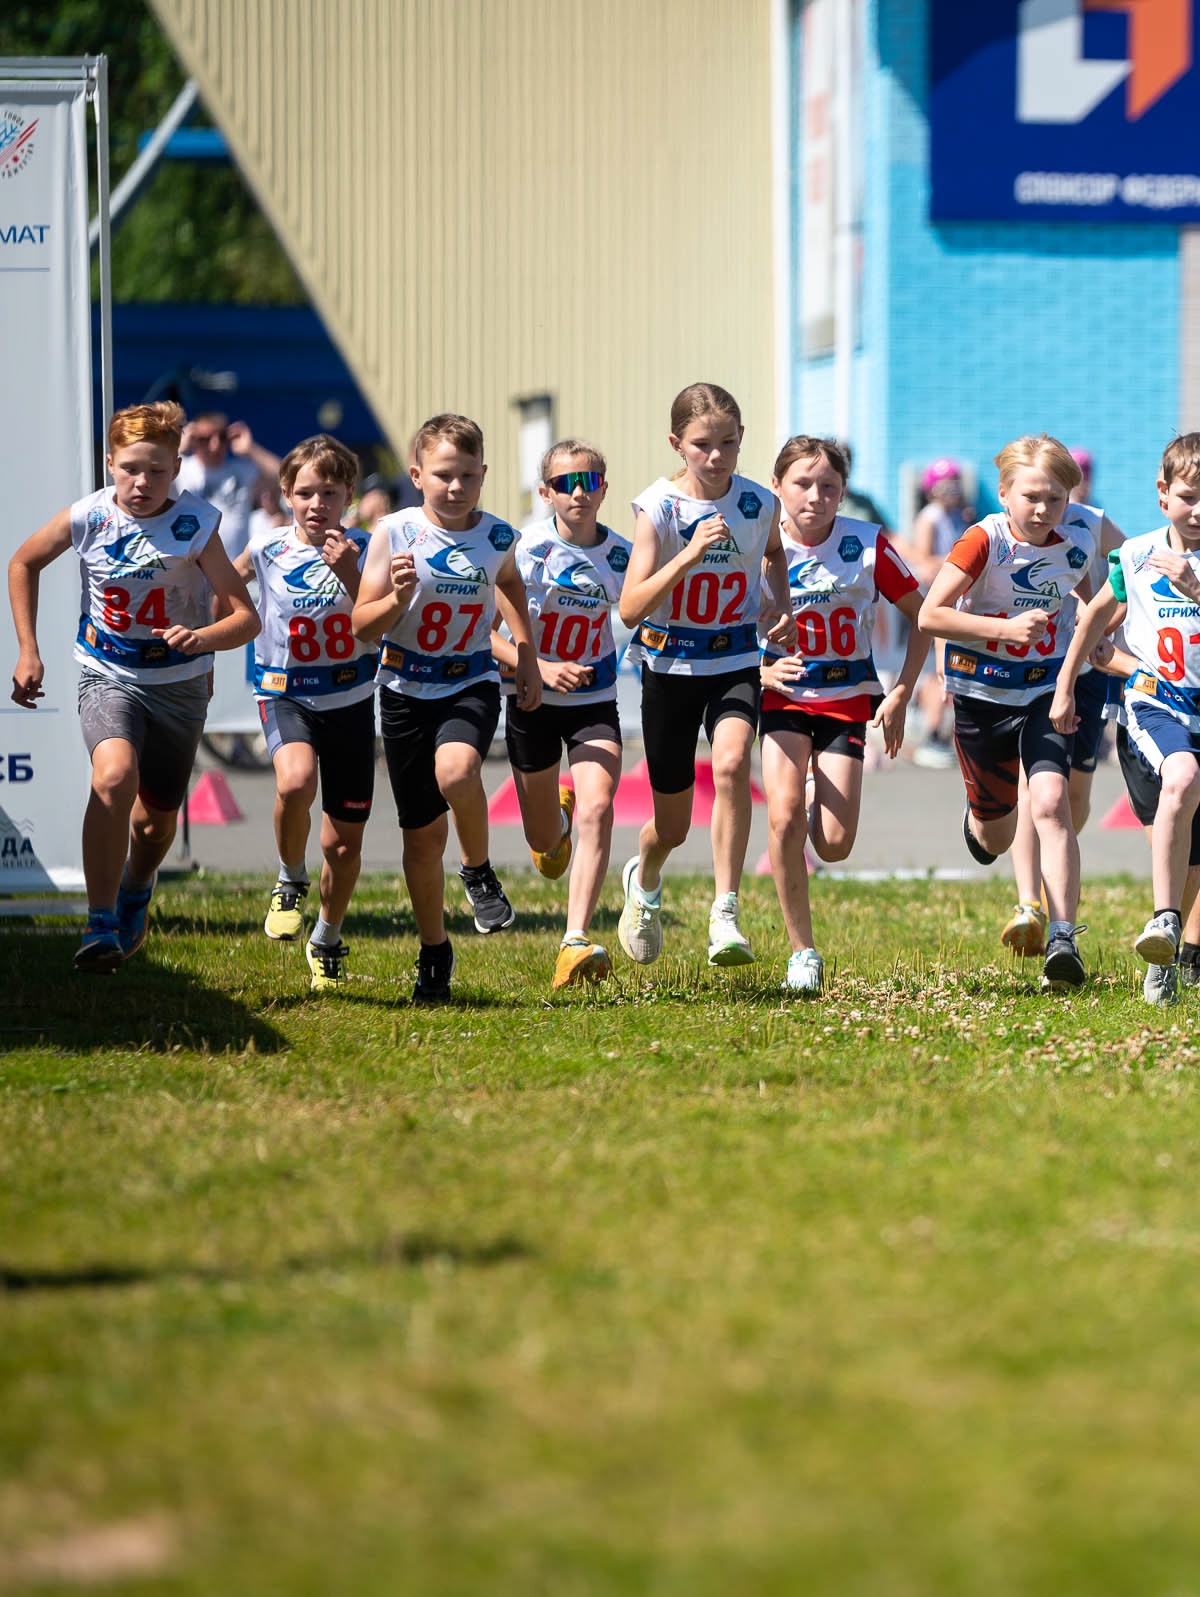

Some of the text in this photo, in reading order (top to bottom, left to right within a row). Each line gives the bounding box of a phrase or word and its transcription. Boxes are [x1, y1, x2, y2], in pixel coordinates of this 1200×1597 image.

[702, 554, 731, 564] РИЖ
[109, 569, 155, 581] СТРИЖ
[435, 583, 481, 595] СТРИЖ
[102, 586, 170, 632] 84
[293, 597, 336, 609] СТРИЖ
[558, 595, 600, 609] СТРИЖ
[668, 571, 747, 625] 102
[1013, 597, 1053, 608] СТРИЖ
[288, 613, 356, 662] 88
[416, 601, 484, 652] 87
[539, 611, 608, 662] 101
[786, 607, 857, 657] 06
[0, 752, 34, 783] Б
